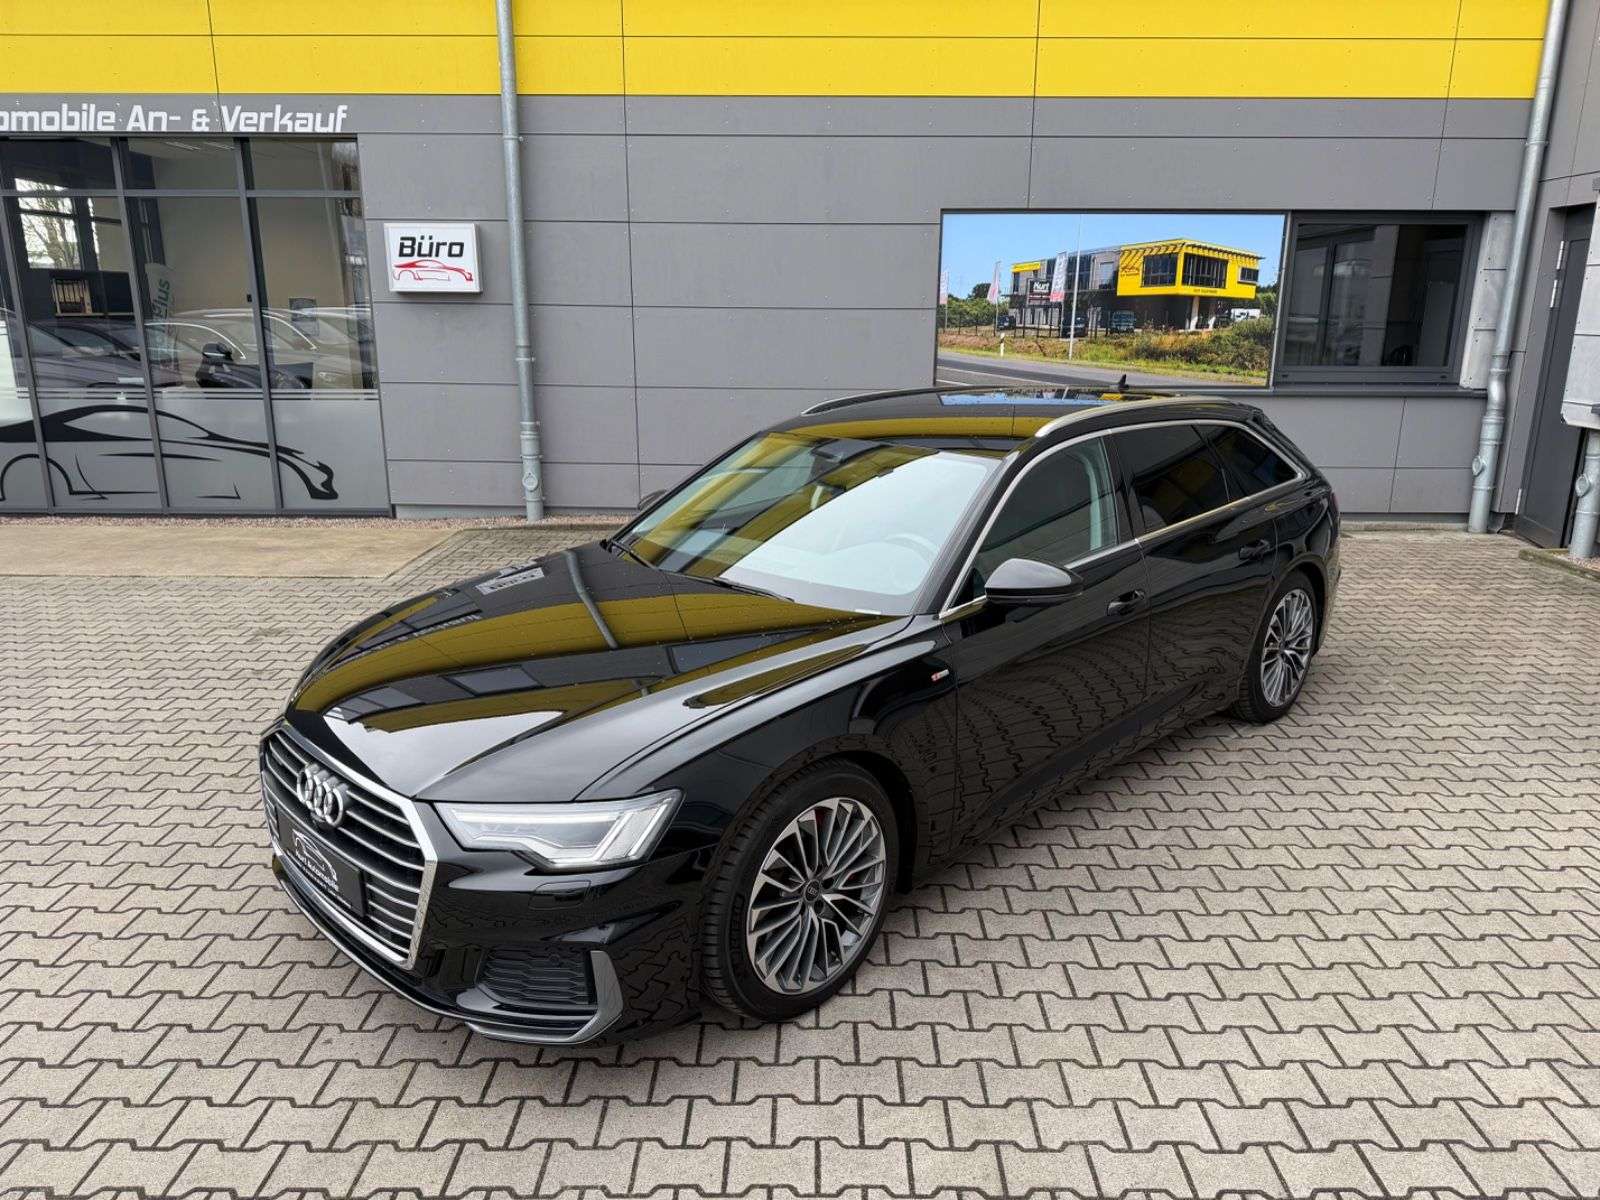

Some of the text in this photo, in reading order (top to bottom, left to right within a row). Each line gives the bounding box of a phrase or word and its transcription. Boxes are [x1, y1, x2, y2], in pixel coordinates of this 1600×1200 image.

[126, 105, 182, 131] An-
[190, 108, 211, 131] &
[219, 104, 347, 132] Verkauf
[399, 235, 465, 258] Büro
